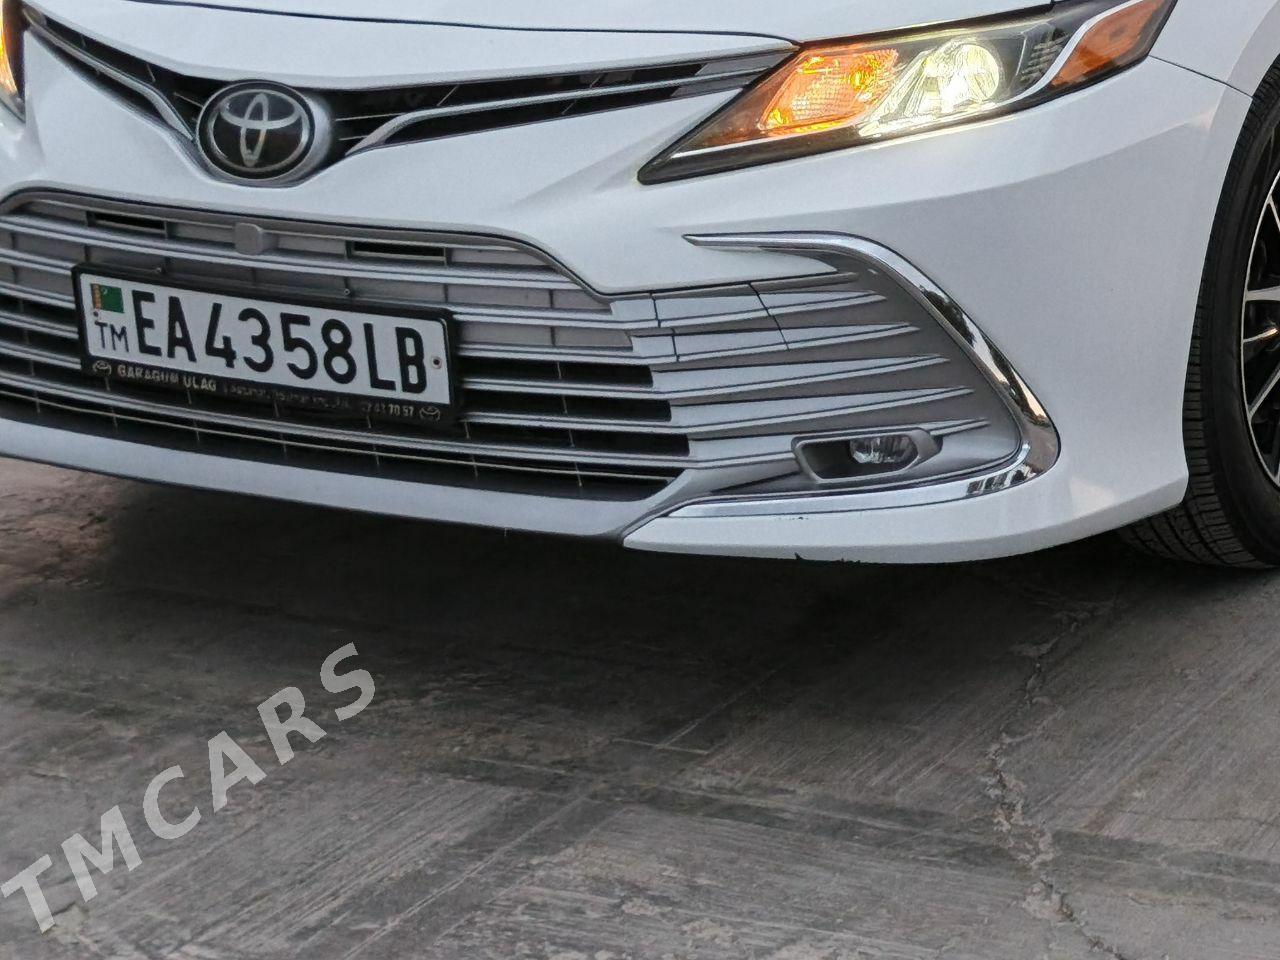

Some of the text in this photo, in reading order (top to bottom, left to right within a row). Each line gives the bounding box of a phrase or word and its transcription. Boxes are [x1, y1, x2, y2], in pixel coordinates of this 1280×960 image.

[97, 321, 130, 354] TM
[131, 288, 428, 394] EA4358LB
[183, 375, 217, 392] ULAG
